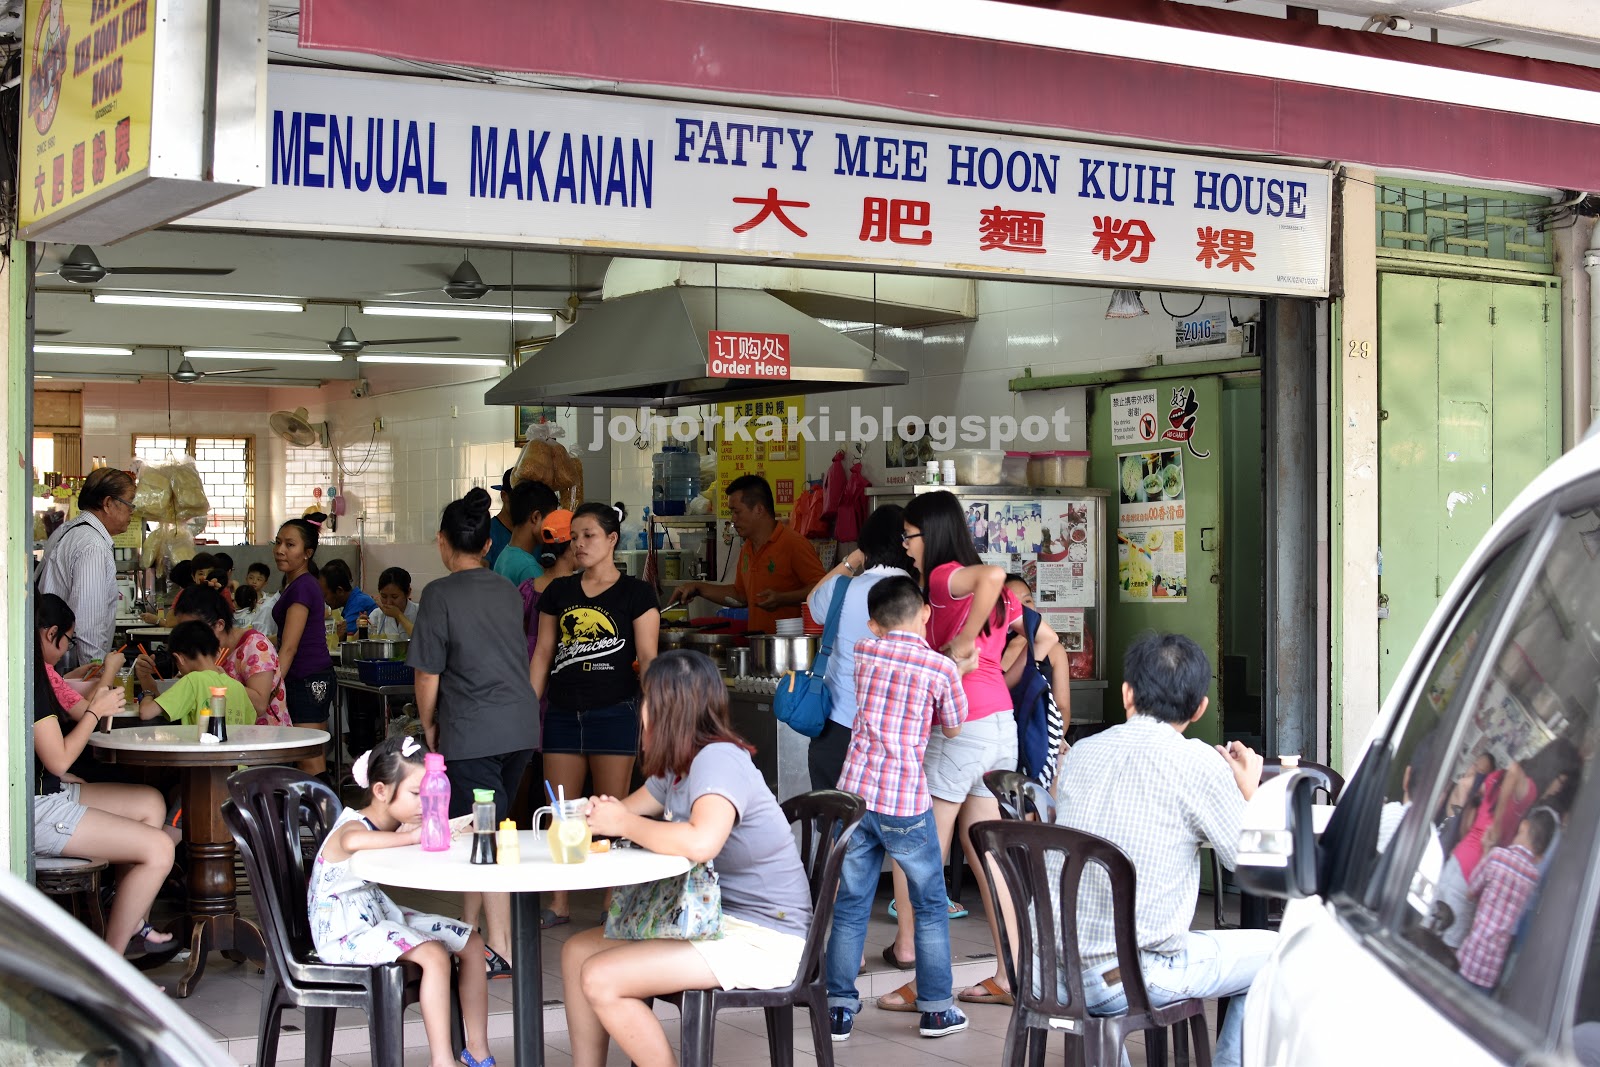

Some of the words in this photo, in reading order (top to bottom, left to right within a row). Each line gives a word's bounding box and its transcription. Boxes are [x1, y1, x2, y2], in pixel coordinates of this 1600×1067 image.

[73, 33, 91, 78] MEE
[93, 14, 119, 66] HOON
[92, 54, 123, 108] HOUSE
[271, 110, 447, 195] MENJUAL
[470, 125, 653, 209] MAKANAN
[674, 118, 813, 171] FATTY
[834, 133, 928, 183] MEE
[947, 144, 1060, 194] HOON
[1078, 158, 1175, 206] KUIH
[1194, 170, 1307, 219] HOUSE
[1184, 319, 1211, 341] 2016
[714, 335, 785, 361] 订购处
[1348, 339, 1371, 359] 29
[712, 360, 751, 374] Order
[755, 361, 787, 376] Here
[1171, 387, 1187, 407] 好
